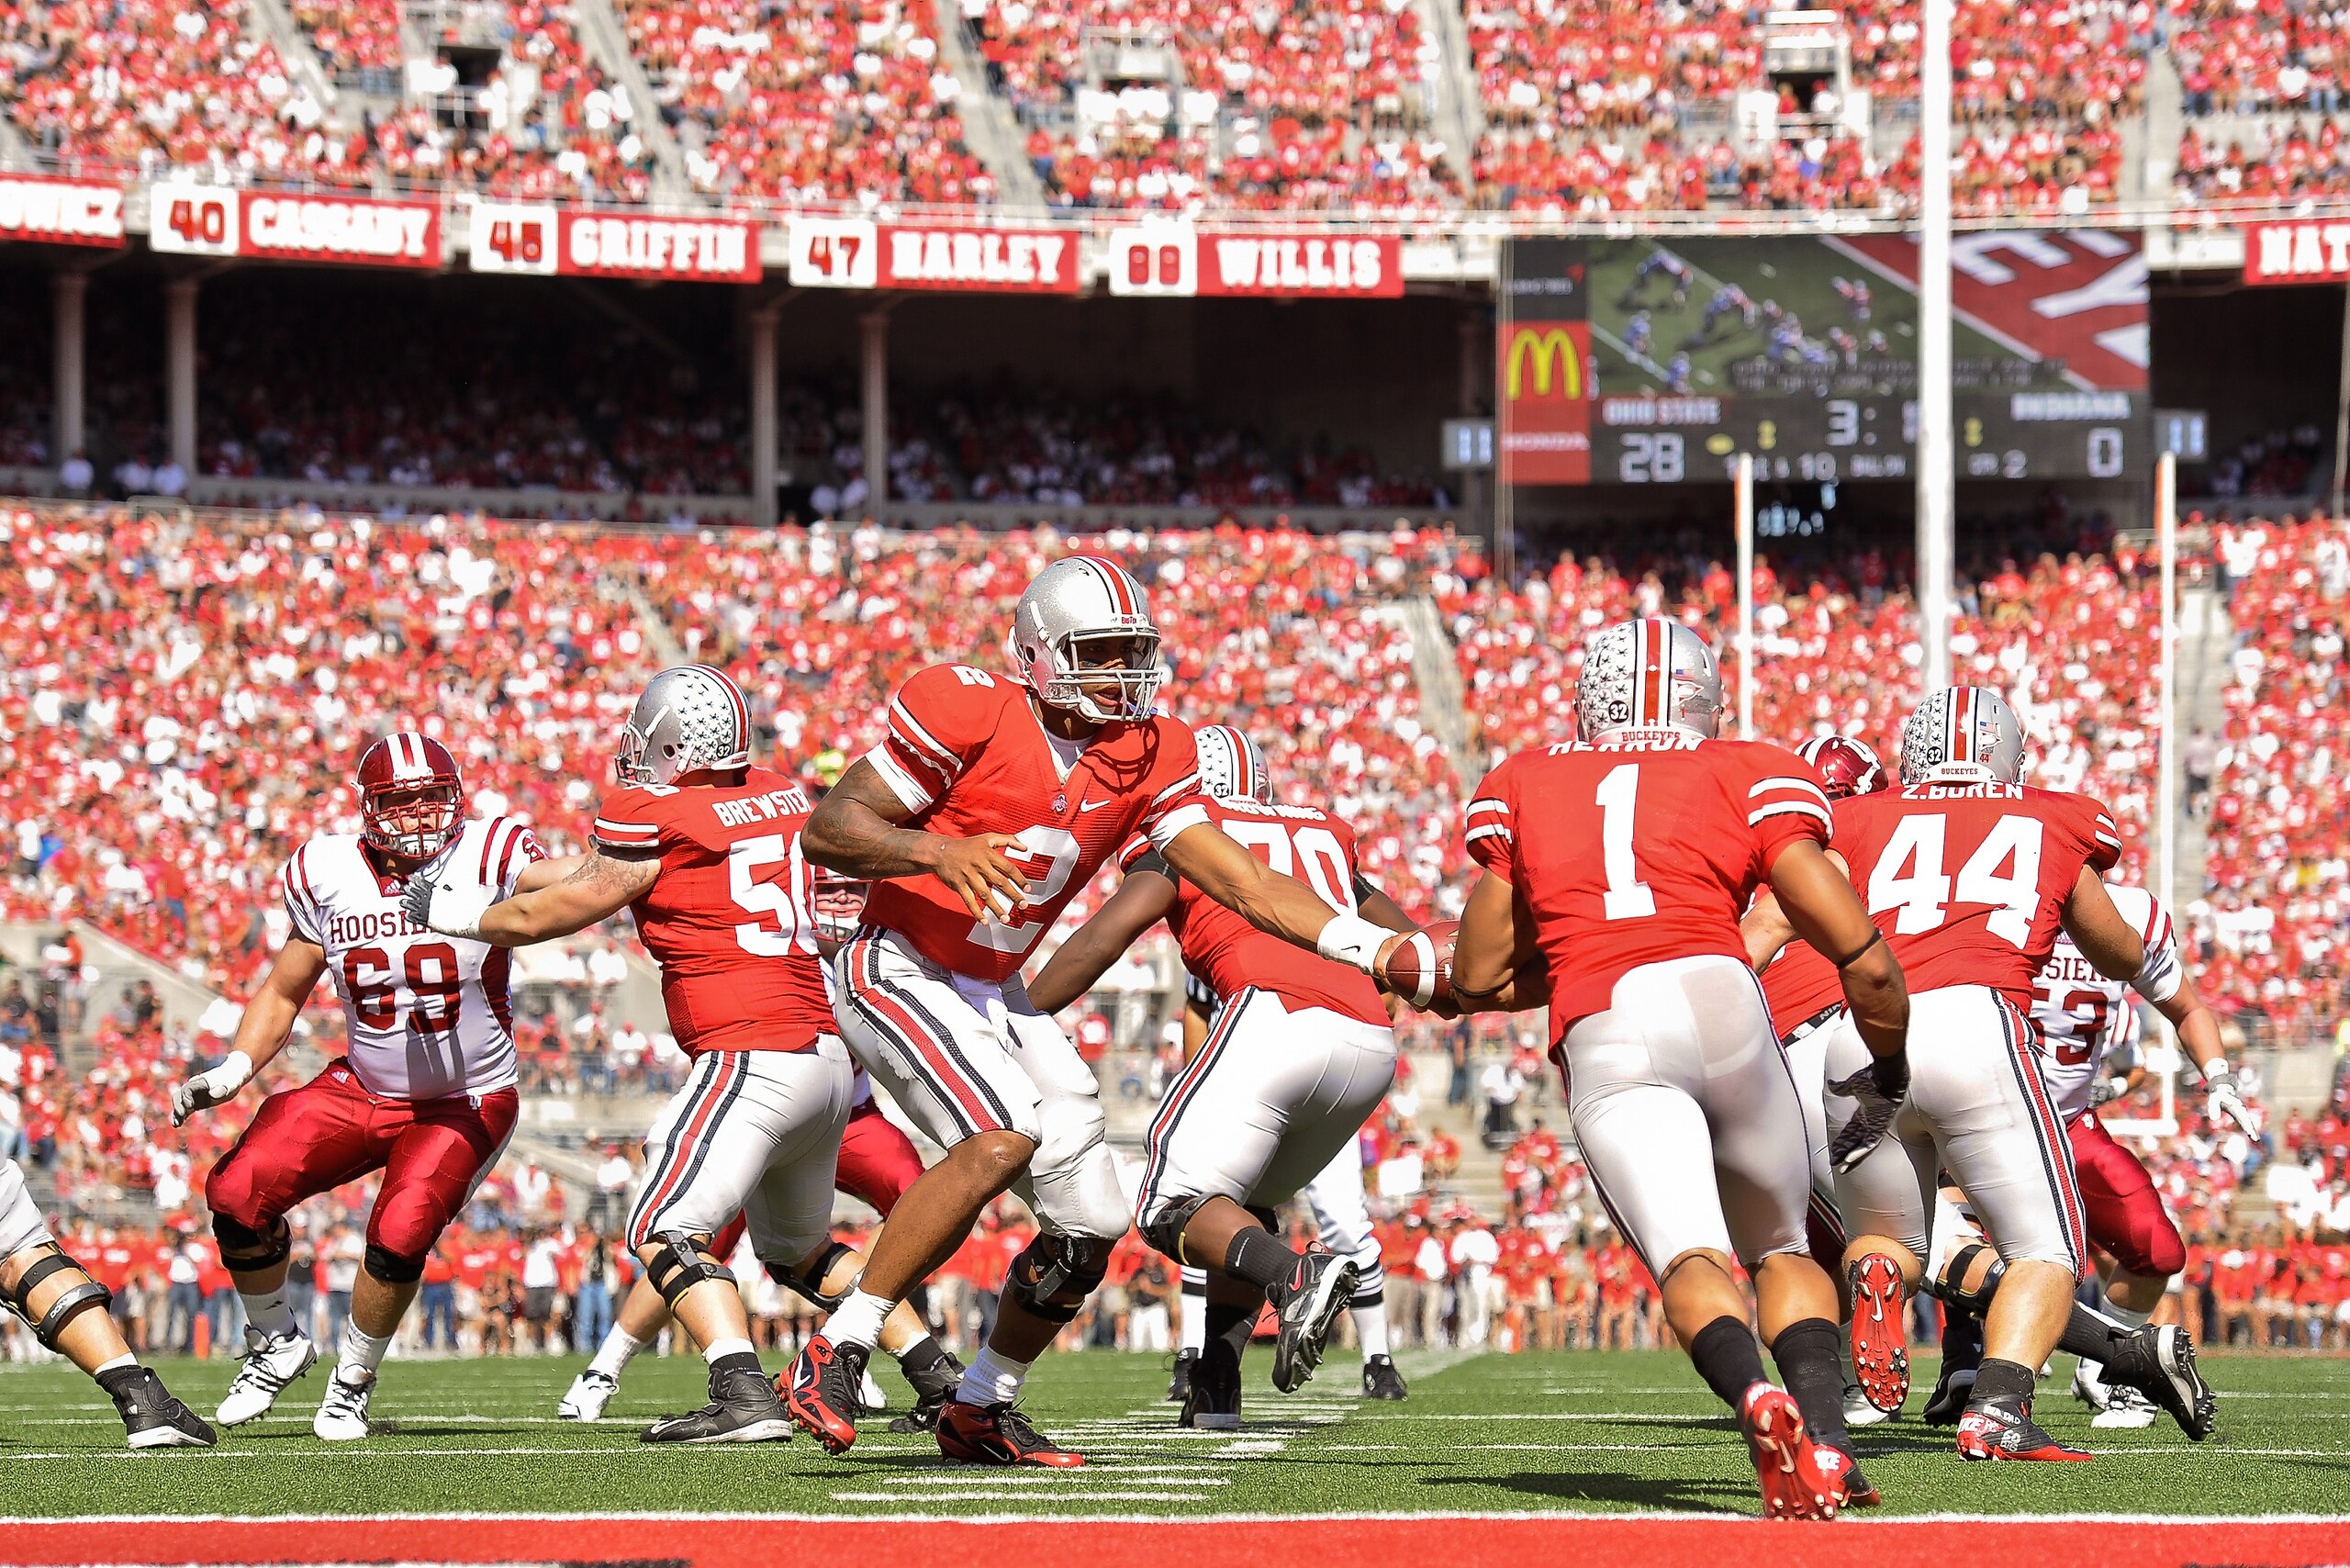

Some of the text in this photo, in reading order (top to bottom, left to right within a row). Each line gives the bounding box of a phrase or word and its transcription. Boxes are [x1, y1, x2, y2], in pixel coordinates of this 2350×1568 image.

[249, 197, 431, 258] CASSADY
[570, 217, 747, 273] GRIFFIN
[809, 231, 1065, 283] 47 HARLEY
[1216, 239, 1382, 289] WILLIS
[1619, 432, 1685, 483] 28
[2087, 427, 2123, 477] 0
[1610, 703, 1628, 721] 32
[1621, 731, 1681, 743] BUCKEYES
[717, 745, 731, 756] 32
[1927, 749, 1942, 763] 32
[1595, 763, 1657, 921] 1
[966, 824, 1081, 953] 2
[1221, 819, 1359, 918] 70
[1867, 812, 2045, 950] 44
[343, 942, 462, 1035] 69
